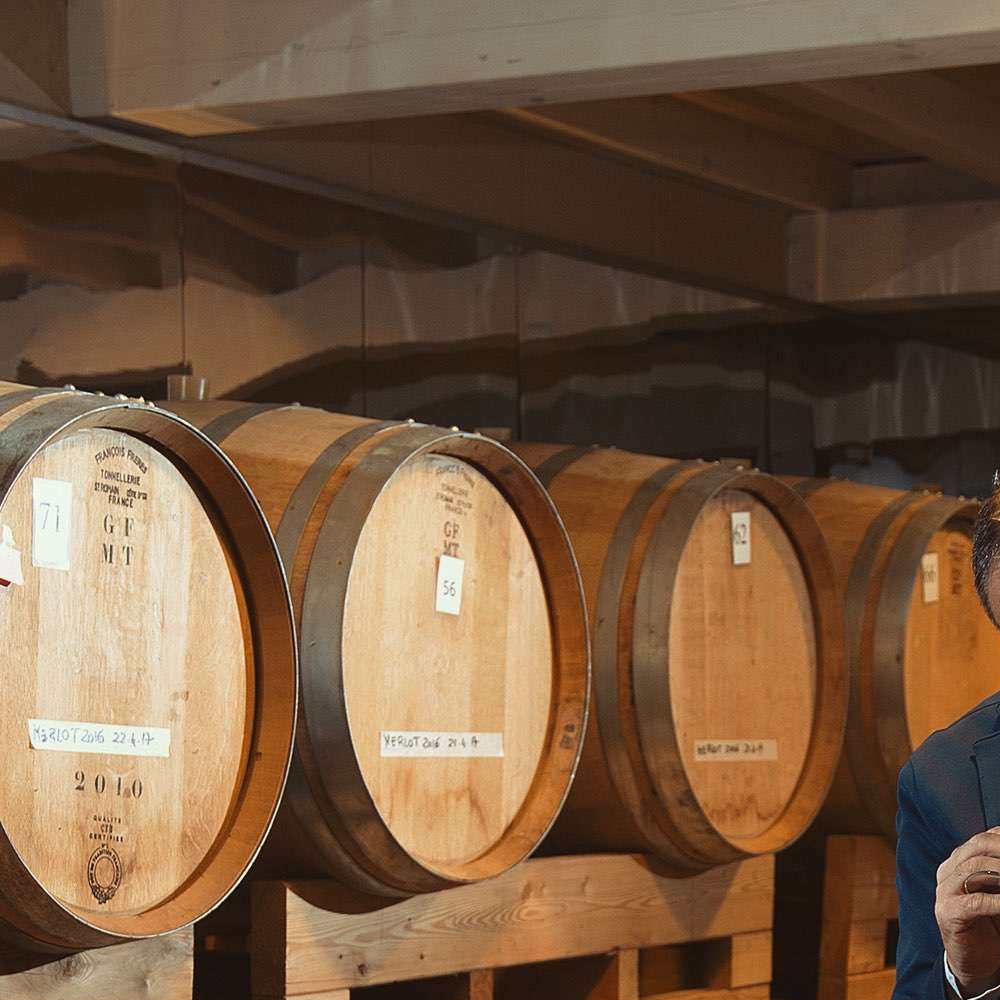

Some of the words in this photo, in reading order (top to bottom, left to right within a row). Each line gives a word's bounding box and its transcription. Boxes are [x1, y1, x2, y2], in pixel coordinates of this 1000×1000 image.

[101, 468, 141, 486] TONNELLERIE
[108, 494, 134, 509] FRANCE
[40, 502, 60, 533] 71
[443, 580, 456, 597] 56
[74, 771, 143, 799] 2010
